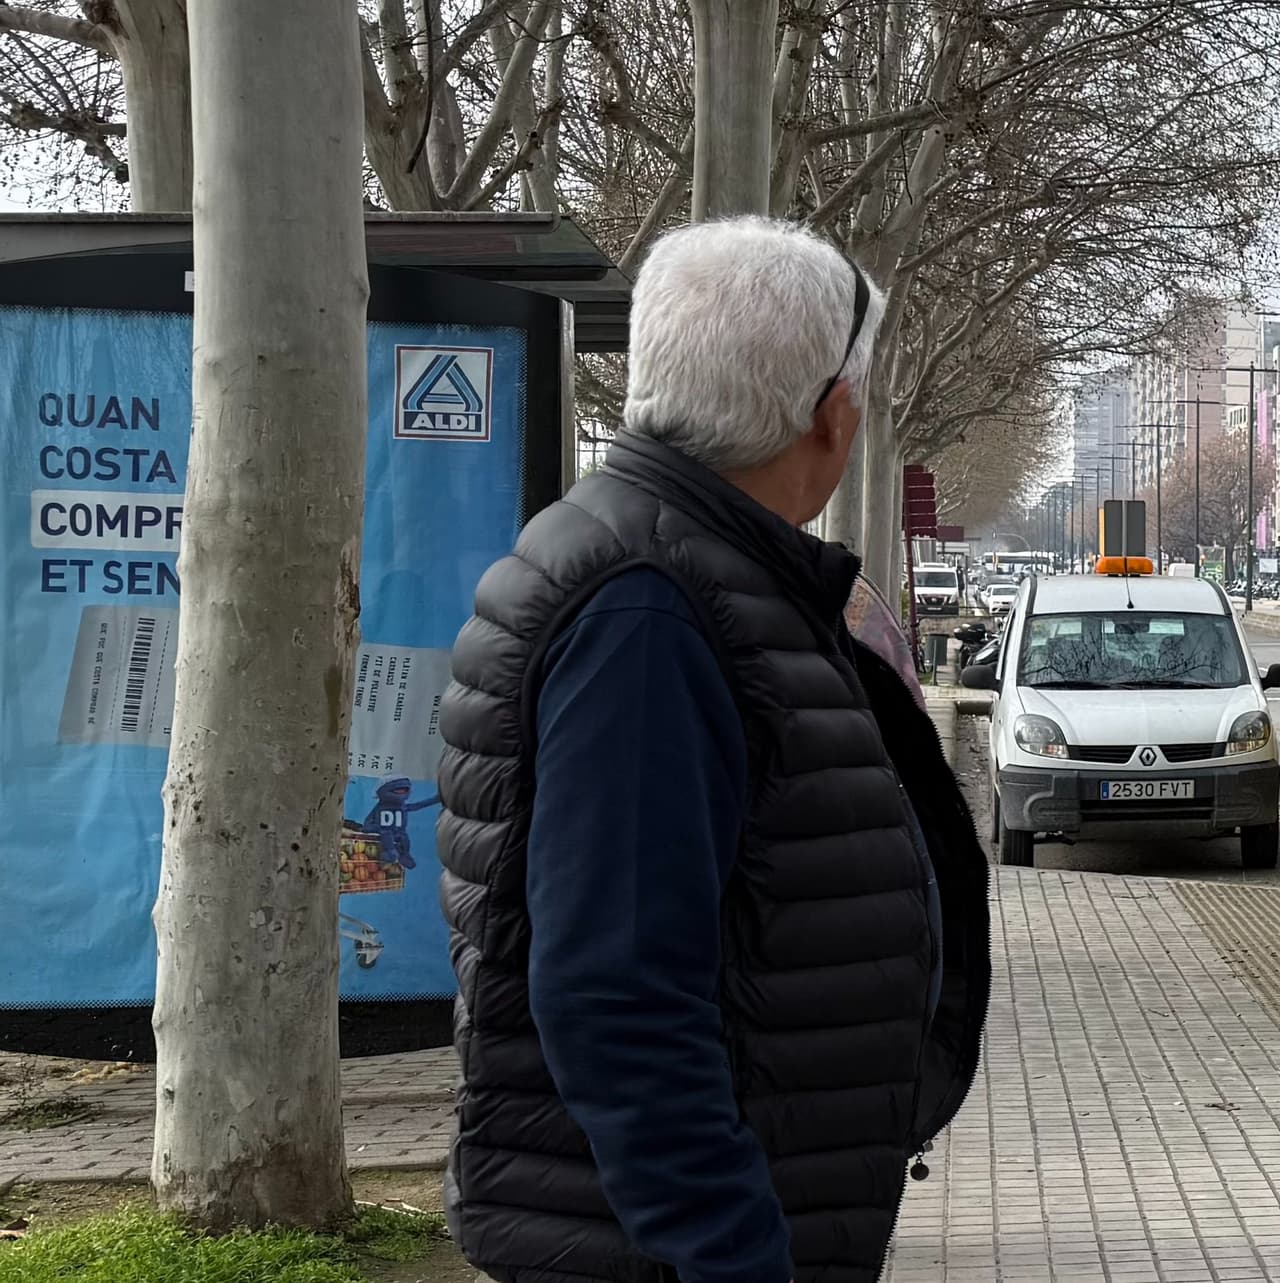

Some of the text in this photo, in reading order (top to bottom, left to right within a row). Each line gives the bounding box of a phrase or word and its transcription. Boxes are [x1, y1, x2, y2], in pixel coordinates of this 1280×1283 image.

[38, 393, 160, 431] QUAN
[411, 413, 476, 430] ALDI
[39, 445, 177, 483] COSTA
[41, 559, 181, 595] ET SEN
[1112, 782, 1191, 798] 2530 FVT
[380, 811, 402, 827] DI
